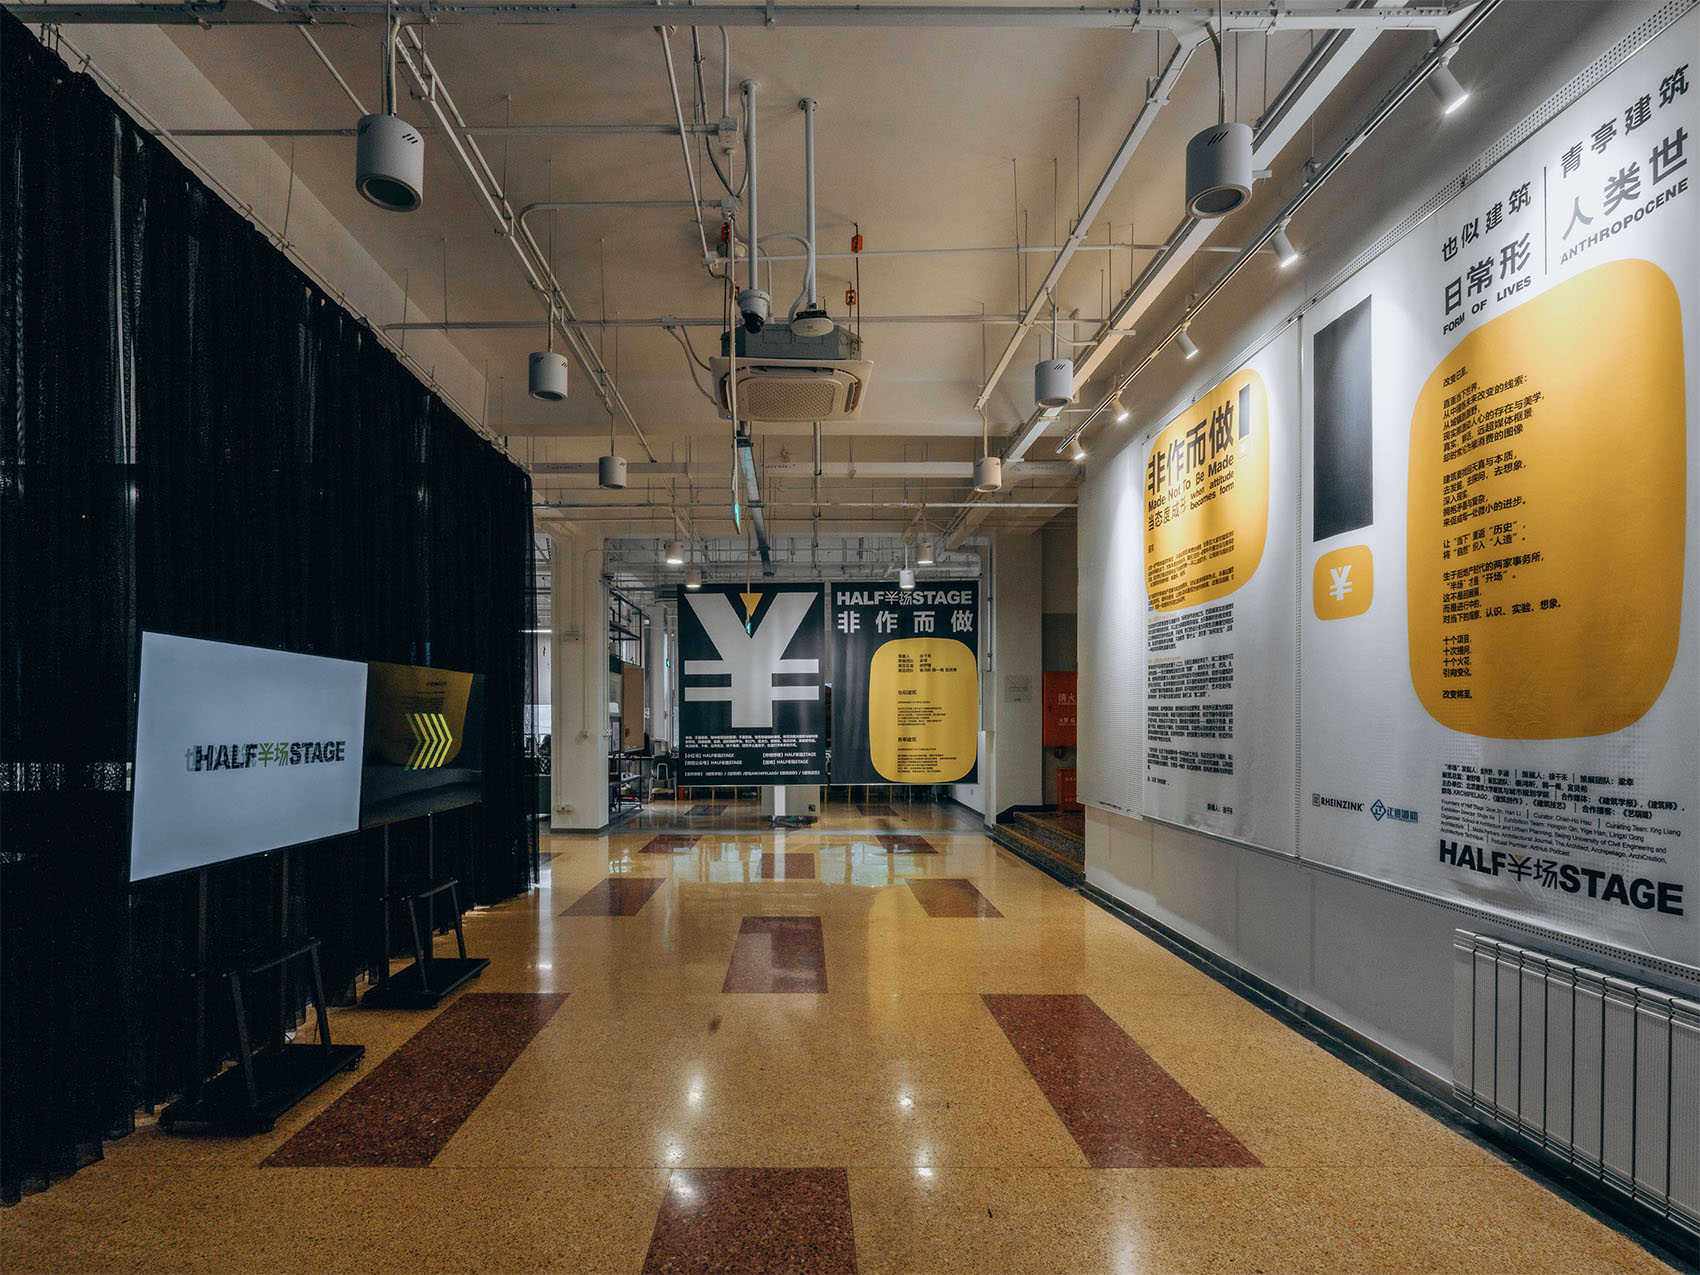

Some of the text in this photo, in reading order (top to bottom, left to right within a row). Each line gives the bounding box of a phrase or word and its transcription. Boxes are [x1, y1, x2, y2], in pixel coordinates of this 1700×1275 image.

[1561, 64, 1688, 179] 青亭建筑
[1562, 127, 1688, 240] 人类世
[1442, 181, 1531, 262] 也似建筑
[1560, 178, 1688, 265] ANTHROPOCENE
[1444, 232, 1530, 316] 日常形
[1443, 276, 1532, 335] FORM OF LIVES
[1148, 400, 1234, 496] 非作而做
[1148, 454, 1234, 513] Made Not To Be Made
[1190, 472, 1234, 500] when attitude
[1190, 481, 1234, 510] becomes form
[838, 610, 973, 633] 非作而做
[1549, 848, 1570, 856] Podcast
[1572, 835, 1599, 846] University
[1608, 840, 1620, 848] Civil
[1622, 842, 1654, 853] Engineering
[1606, 822, 1631, 832] Curating
[1649, 827, 1661, 835] Xing
[1663, 829, 1681, 837] Liang
[1629, 834, 1644, 842] Gong
